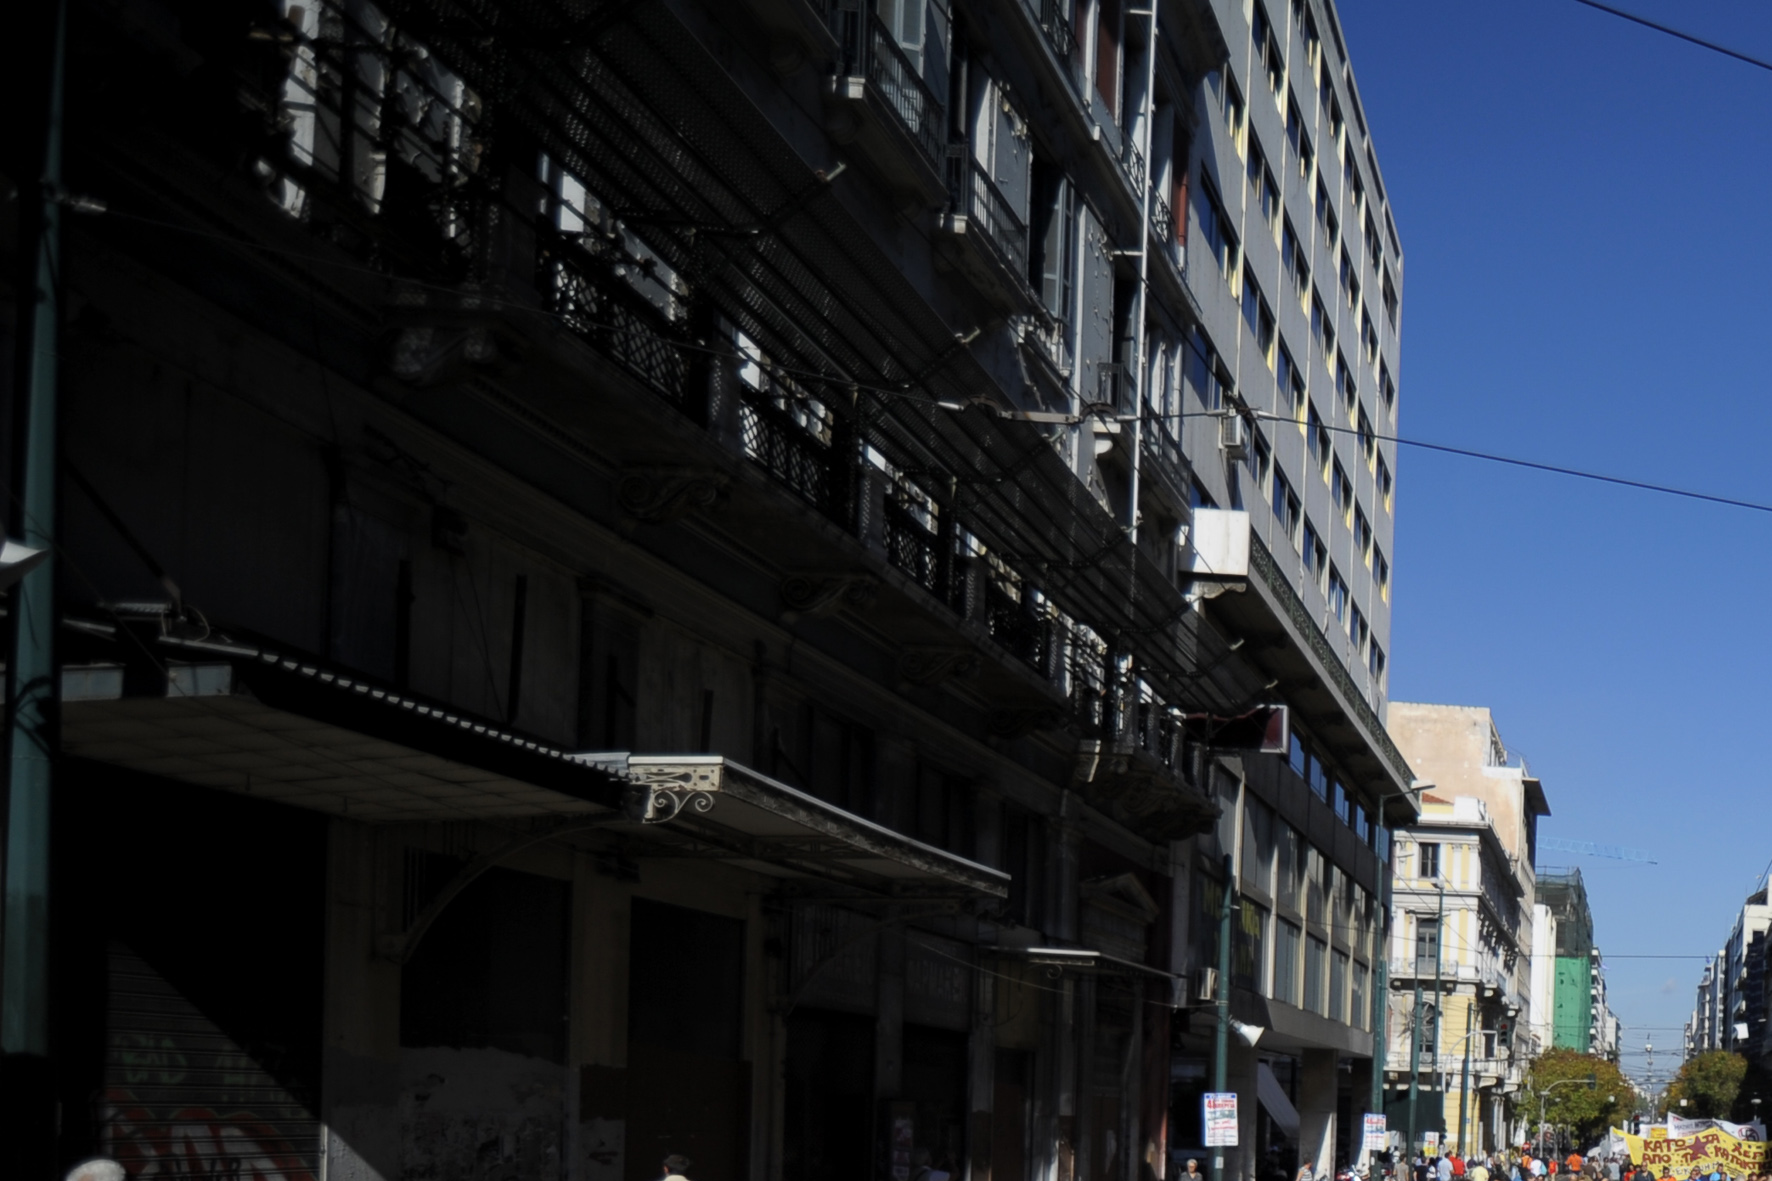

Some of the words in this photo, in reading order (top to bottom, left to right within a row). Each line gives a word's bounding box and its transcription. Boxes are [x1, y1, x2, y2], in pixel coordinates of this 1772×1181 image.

[1643, 1138, 1687, 1153] ΚΑΤΩ
[1702, 1133, 1720, 1144] ΤΑ
[1642, 1152, 1672, 1165] ΑΠΟ
